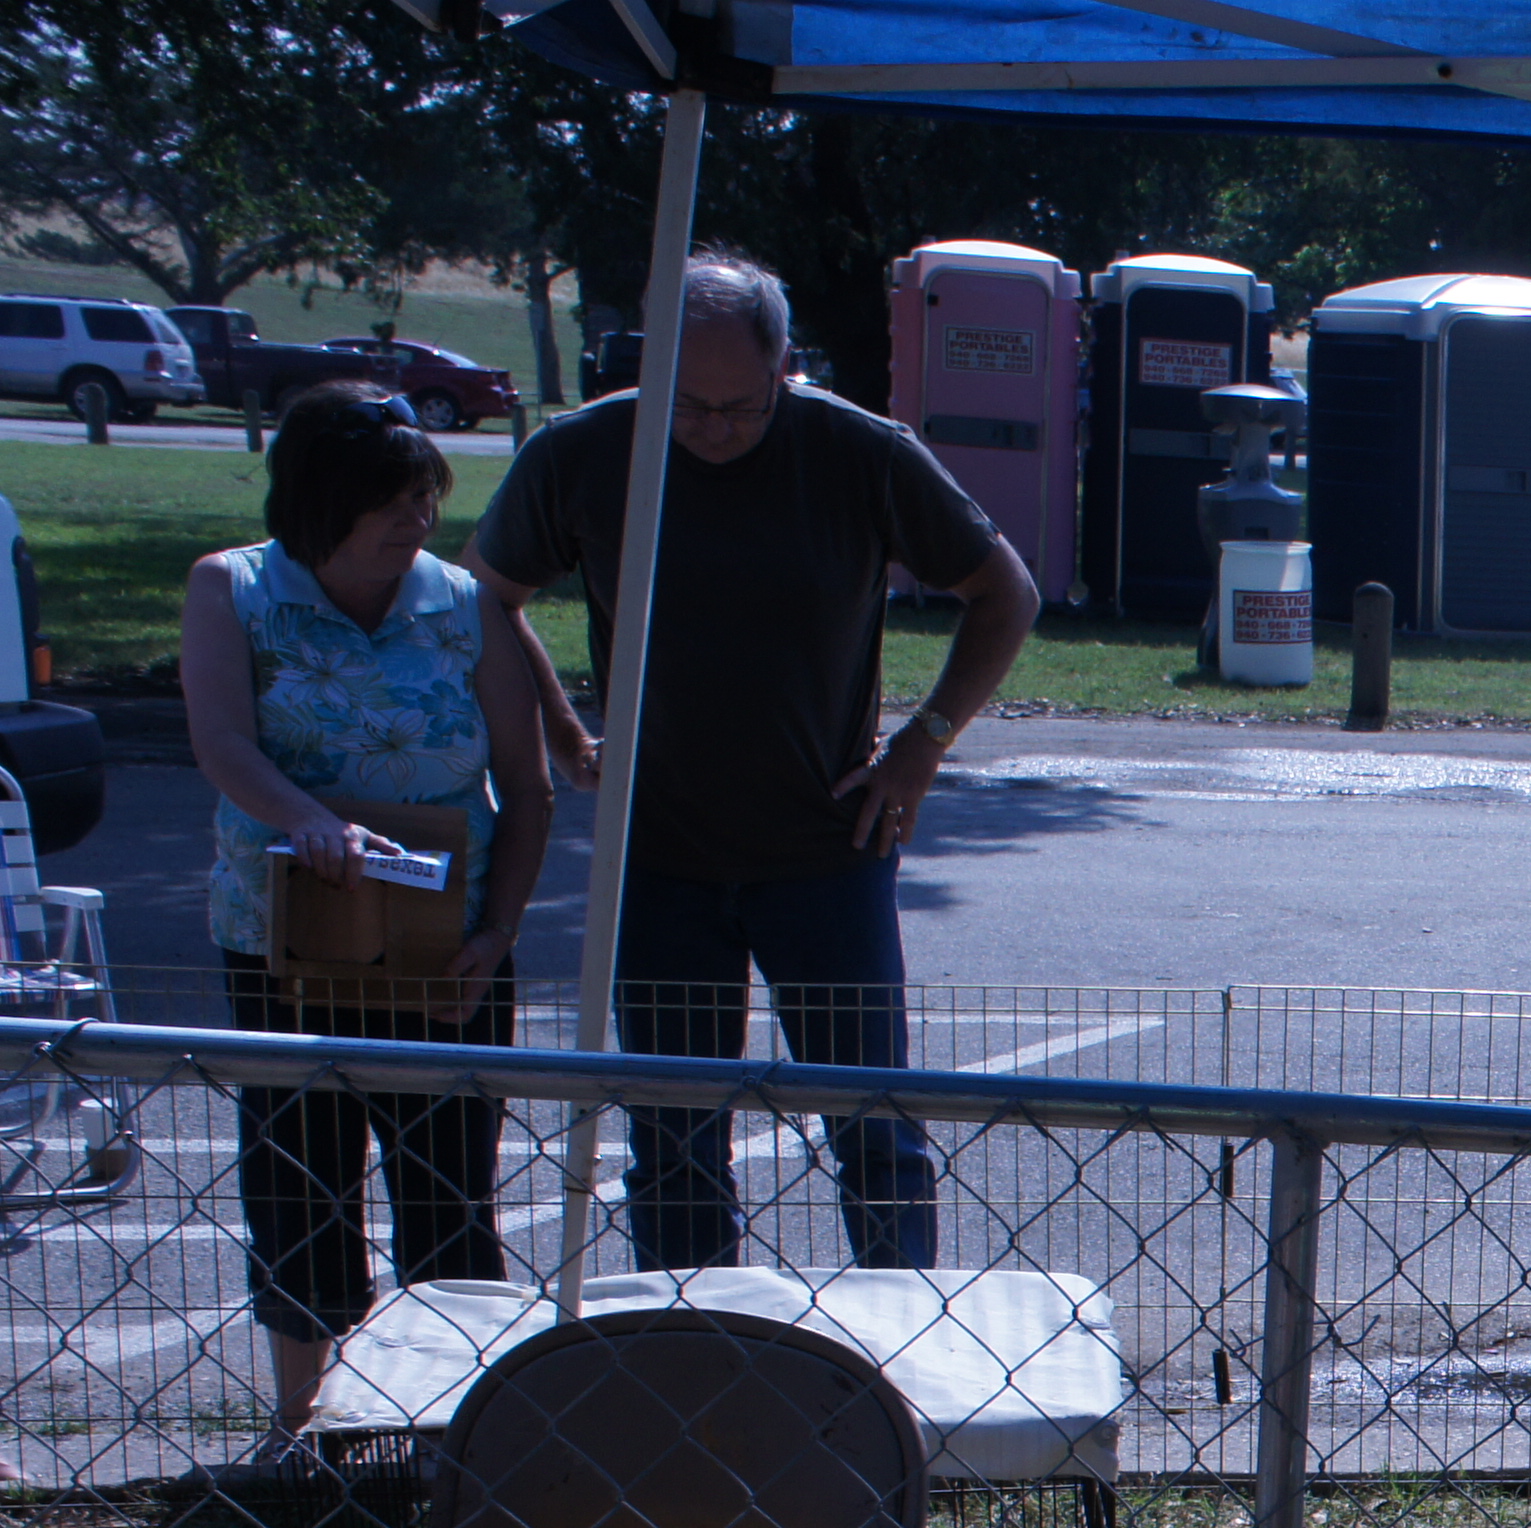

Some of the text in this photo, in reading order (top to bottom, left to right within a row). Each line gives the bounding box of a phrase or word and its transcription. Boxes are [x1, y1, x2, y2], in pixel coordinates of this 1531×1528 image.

[956, 331, 1021, 343] PRESTIGE
[950, 340, 1028, 354] PORTABLES
[1151, 344, 1220, 357] PRESTIGE
[1145, 353, 1227, 368] PORTABLES
